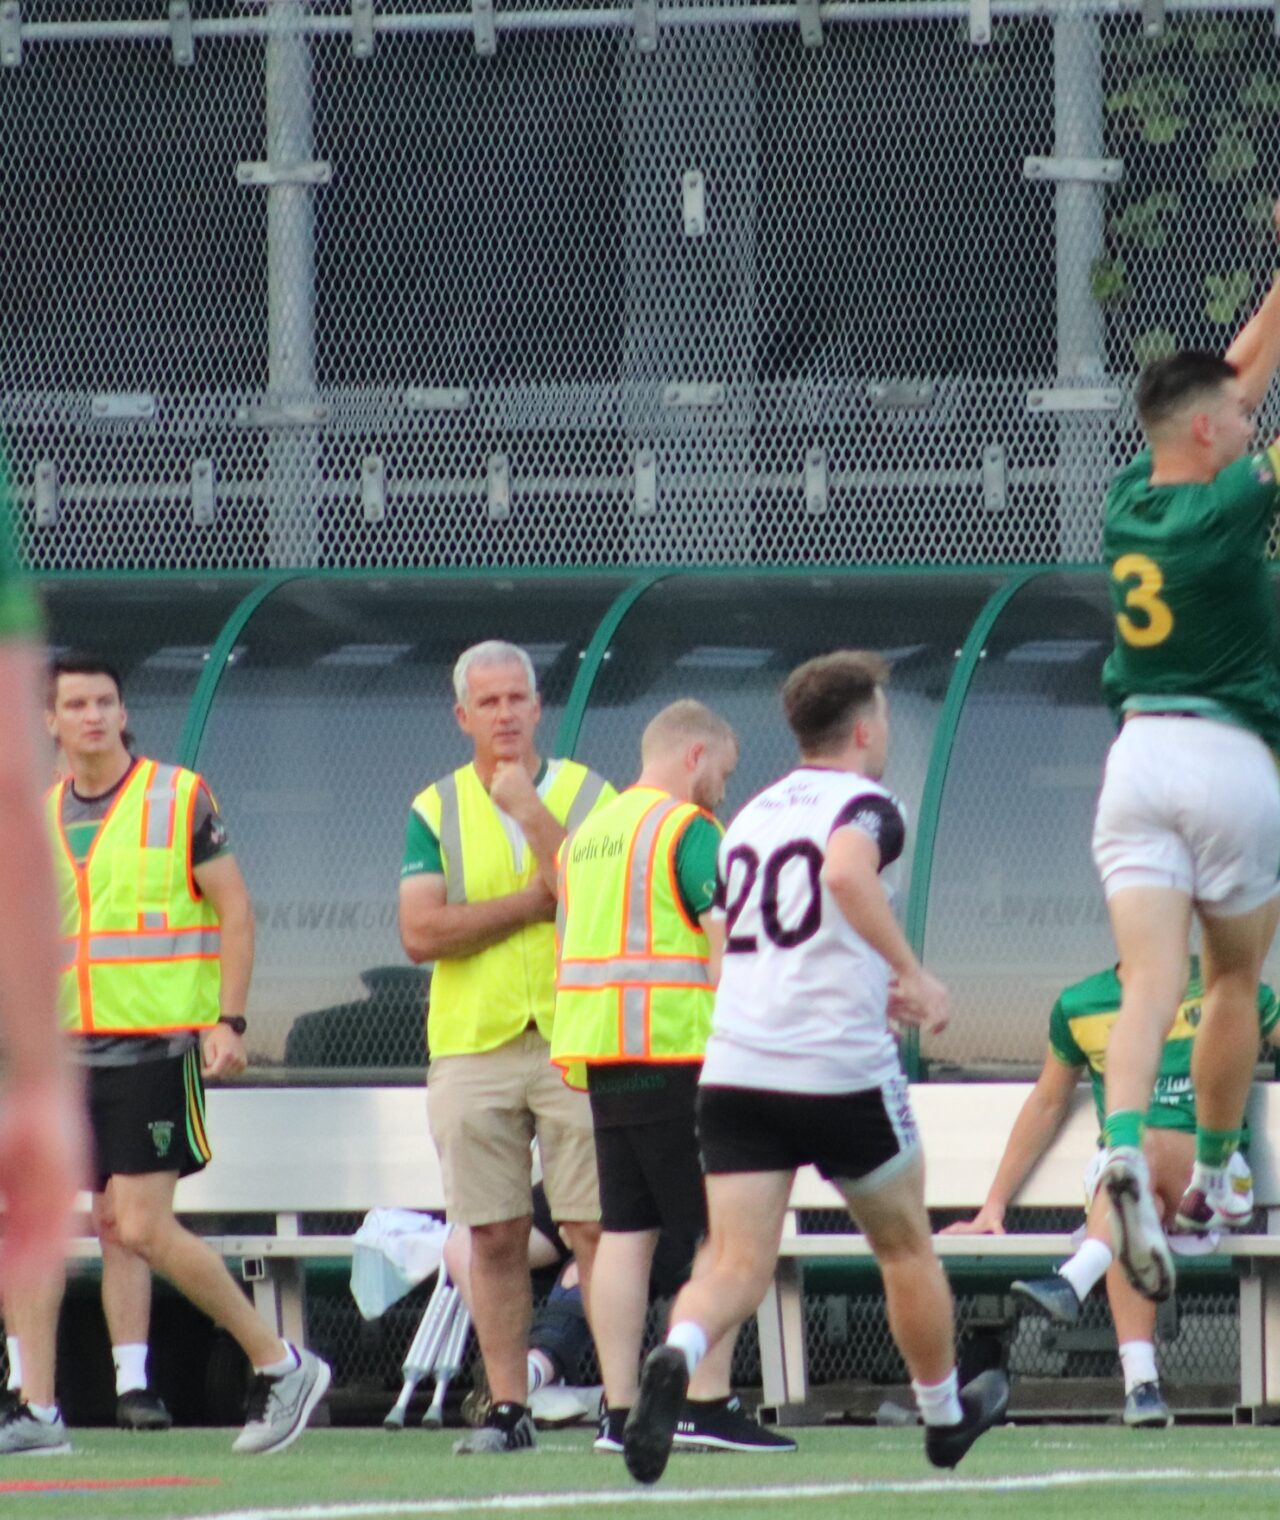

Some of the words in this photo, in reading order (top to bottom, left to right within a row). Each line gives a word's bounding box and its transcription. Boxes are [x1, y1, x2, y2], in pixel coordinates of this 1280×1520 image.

[1113, 553, 1173, 647] 3
[601, 832, 624, 859] Park
[270, 901, 397, 929] KWIKGO
[725, 837, 824, 953] 20
